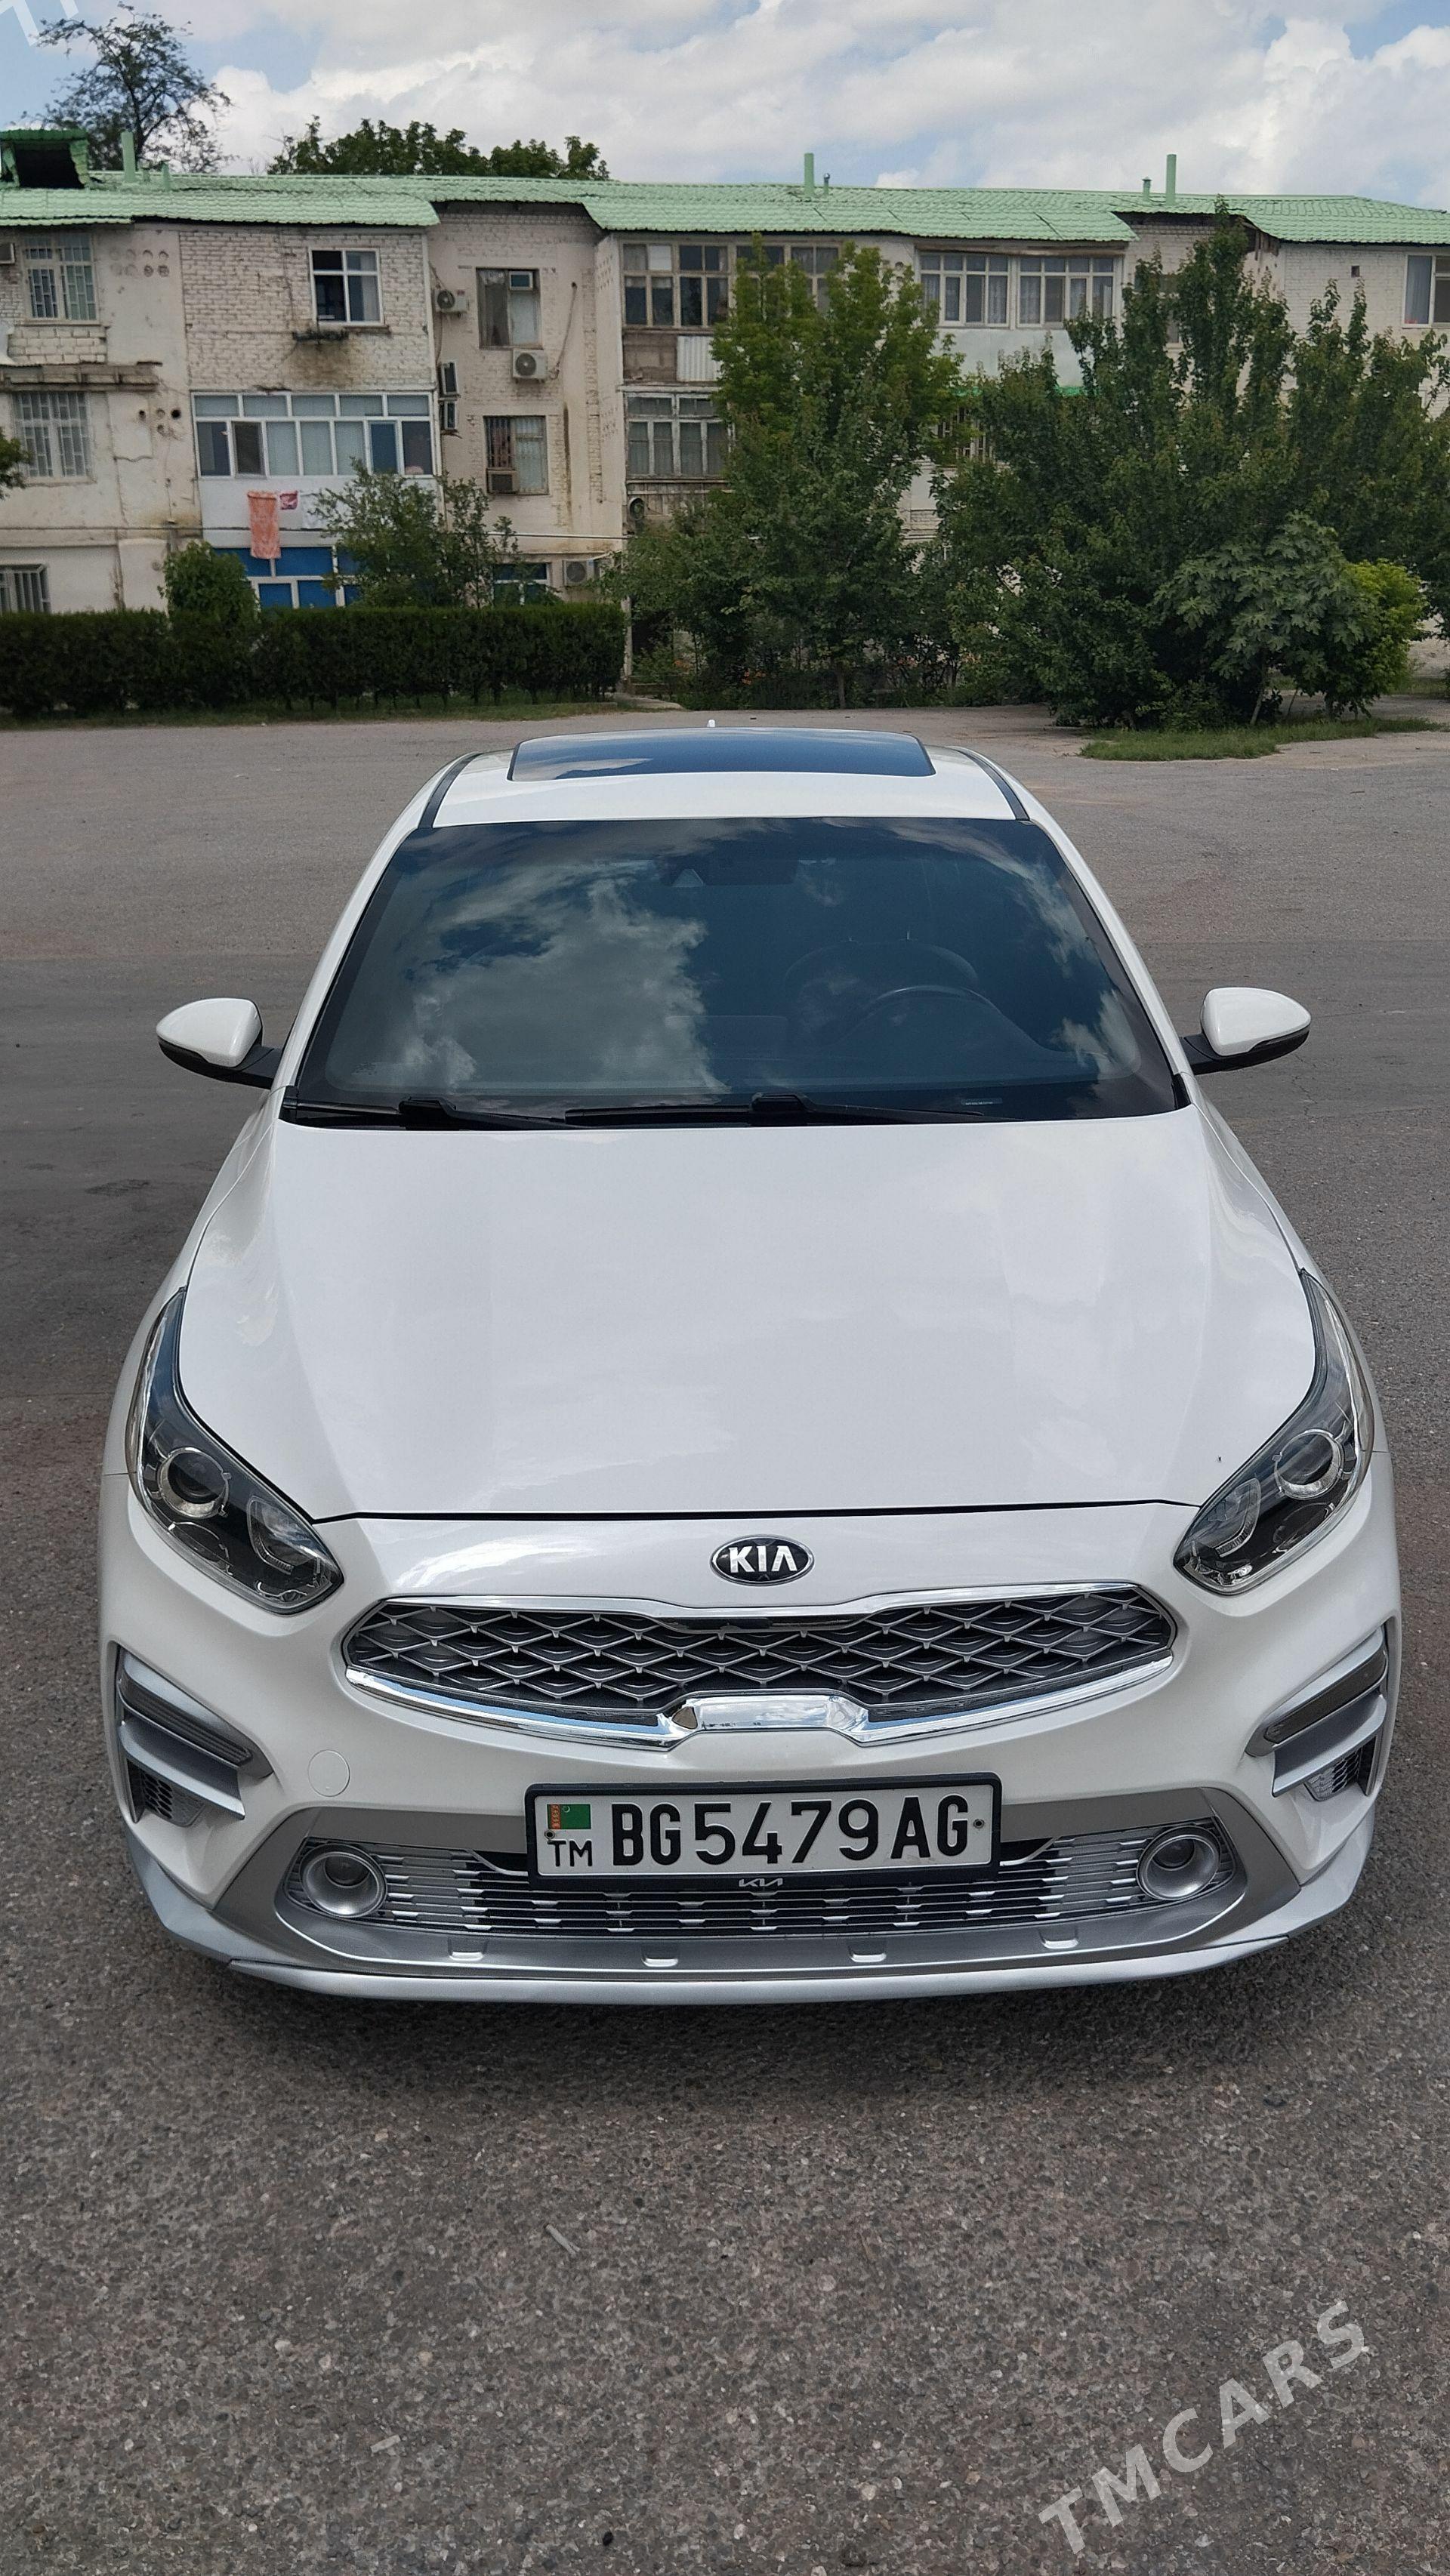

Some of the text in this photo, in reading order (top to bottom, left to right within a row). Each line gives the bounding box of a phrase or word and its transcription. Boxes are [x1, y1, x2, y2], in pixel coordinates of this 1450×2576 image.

[728, 1545, 798, 1573] KIA
[611, 1793, 968, 1866] BG5479AG
[547, 1839, 593, 1867] TM
